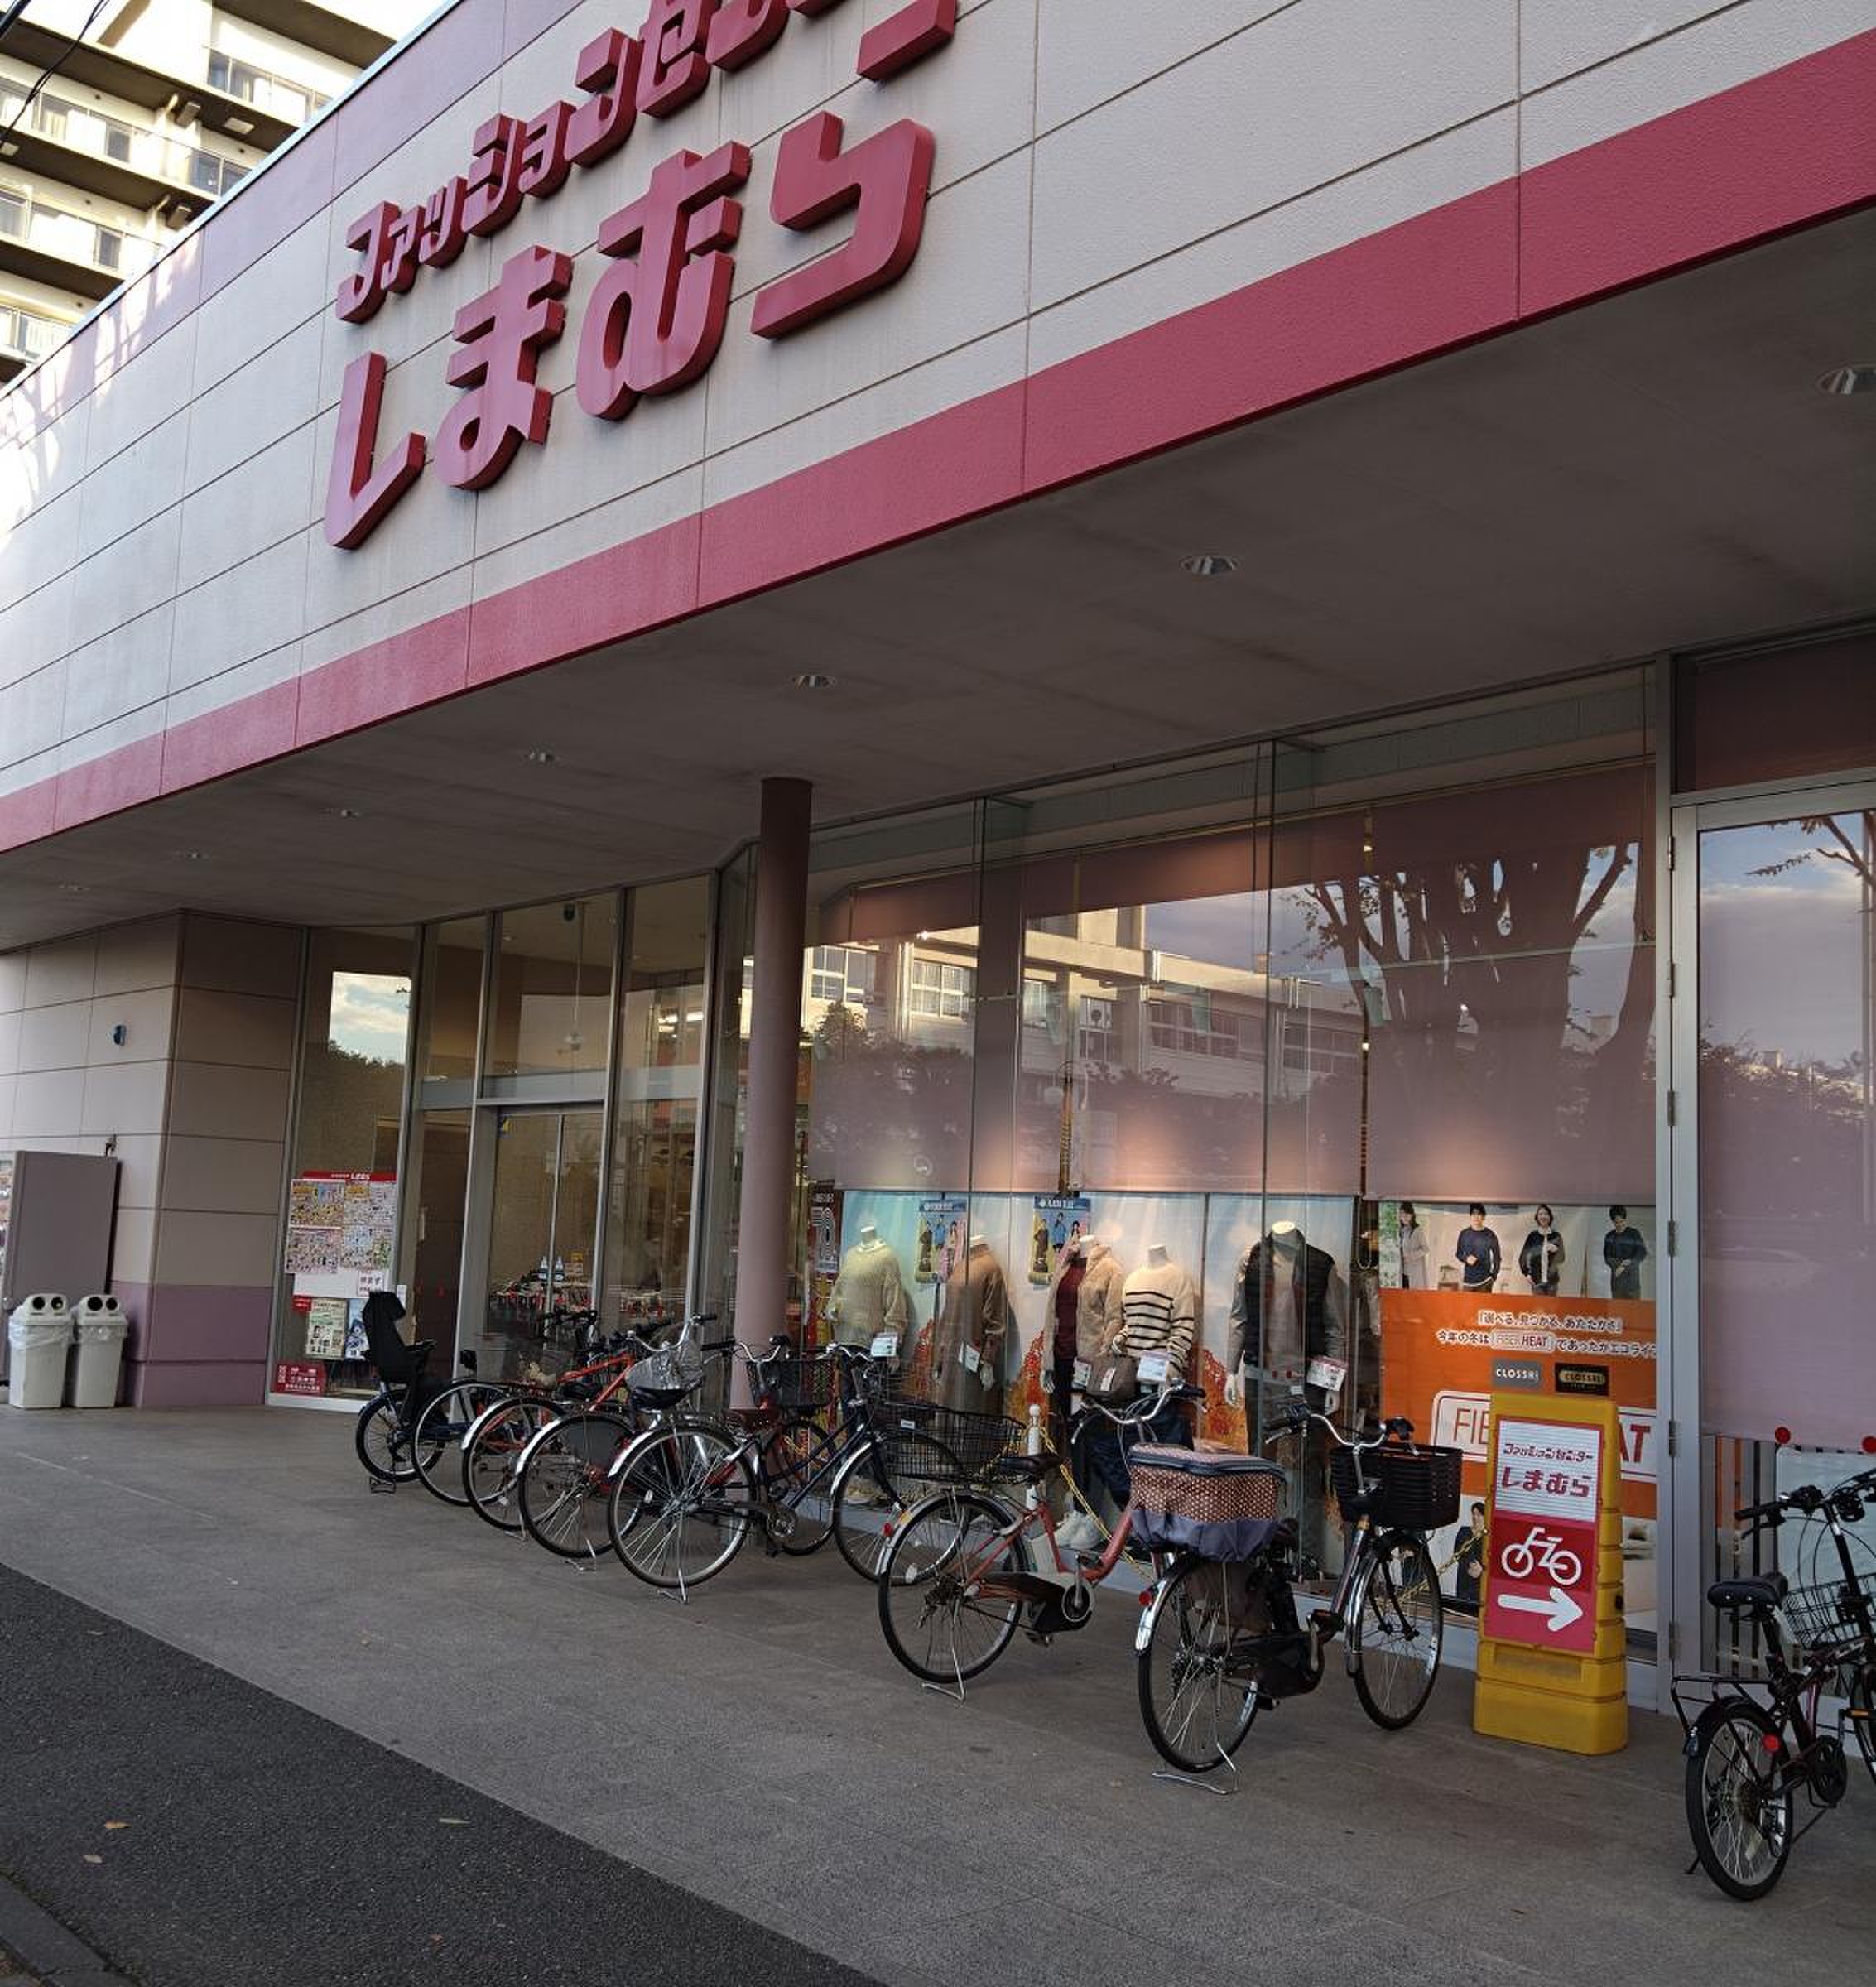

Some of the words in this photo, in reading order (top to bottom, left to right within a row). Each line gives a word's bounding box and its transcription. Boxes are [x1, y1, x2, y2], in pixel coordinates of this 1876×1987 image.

[325, 0, 956, 551] しまむら
[1503, 1443, 1594, 1463] ファッションセンター
[1501, 1466, 1592, 1498] しまむら
